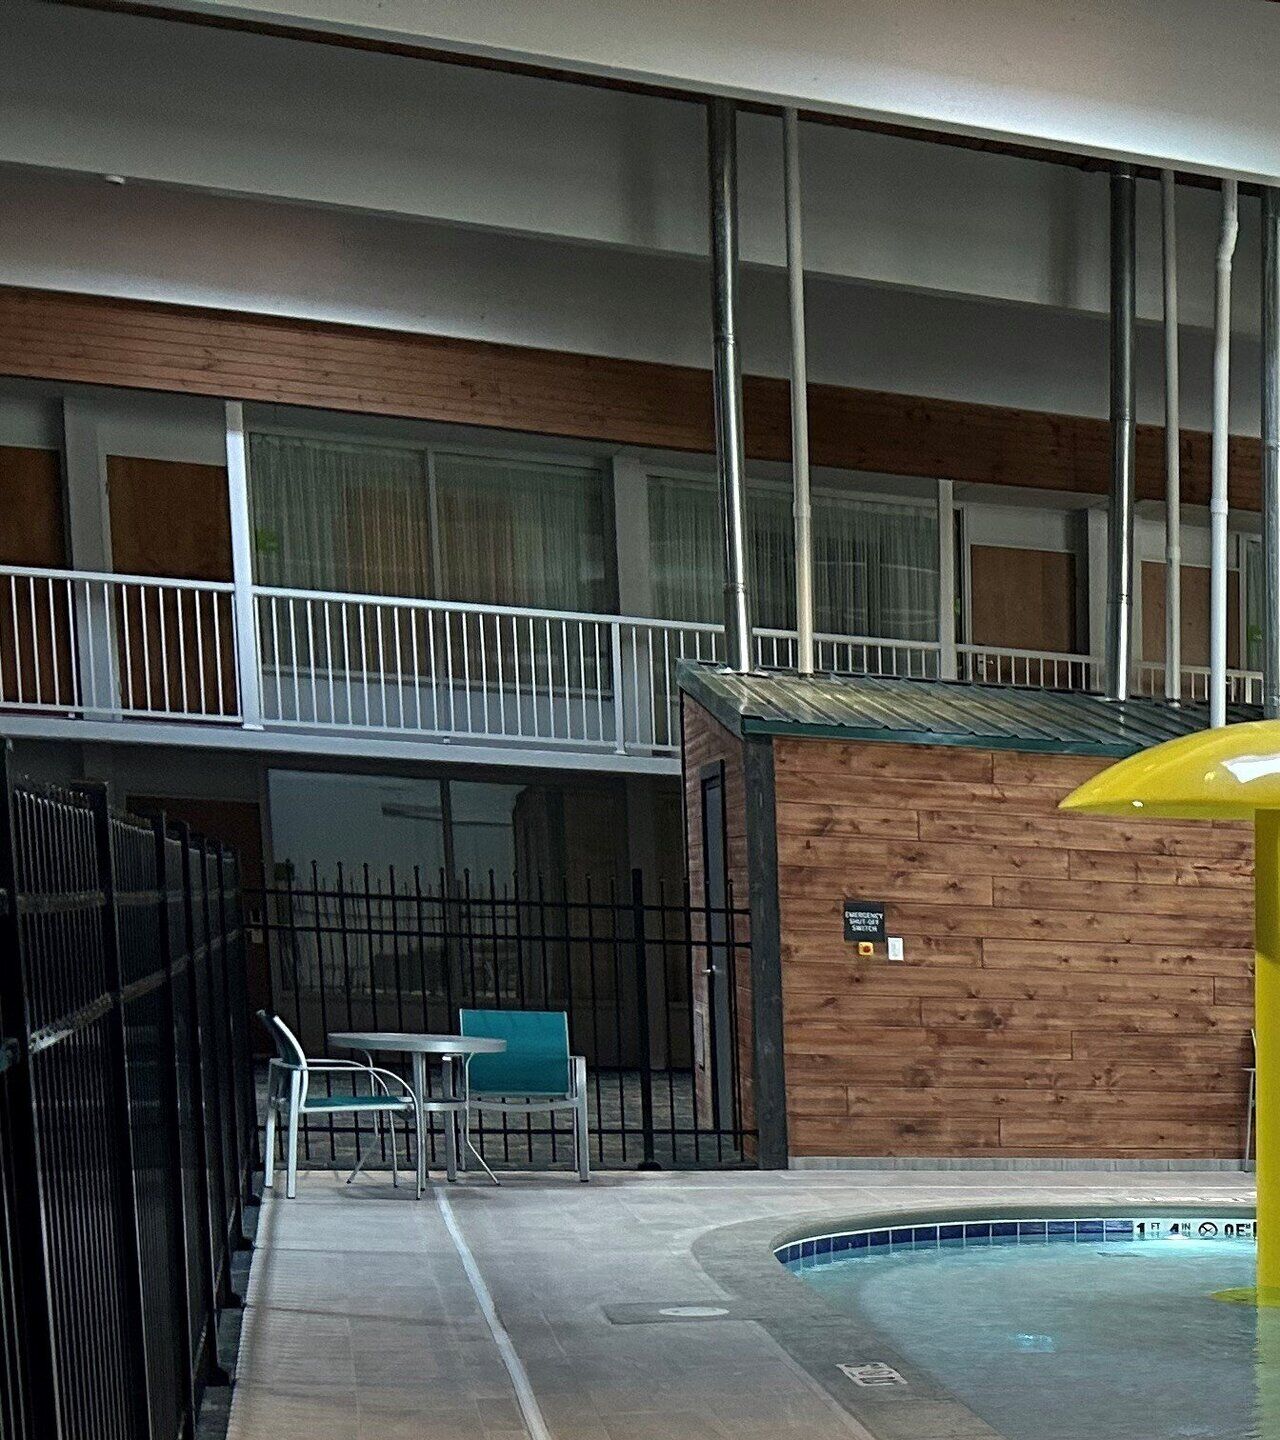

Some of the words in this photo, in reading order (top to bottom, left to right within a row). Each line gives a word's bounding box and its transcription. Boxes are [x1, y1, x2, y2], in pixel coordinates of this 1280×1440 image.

[845, 911, 883, 920] EMERGENCY
[1151, 1222, 1160, 1230] FT
[1182, 1222, 1191, 1230] IN
